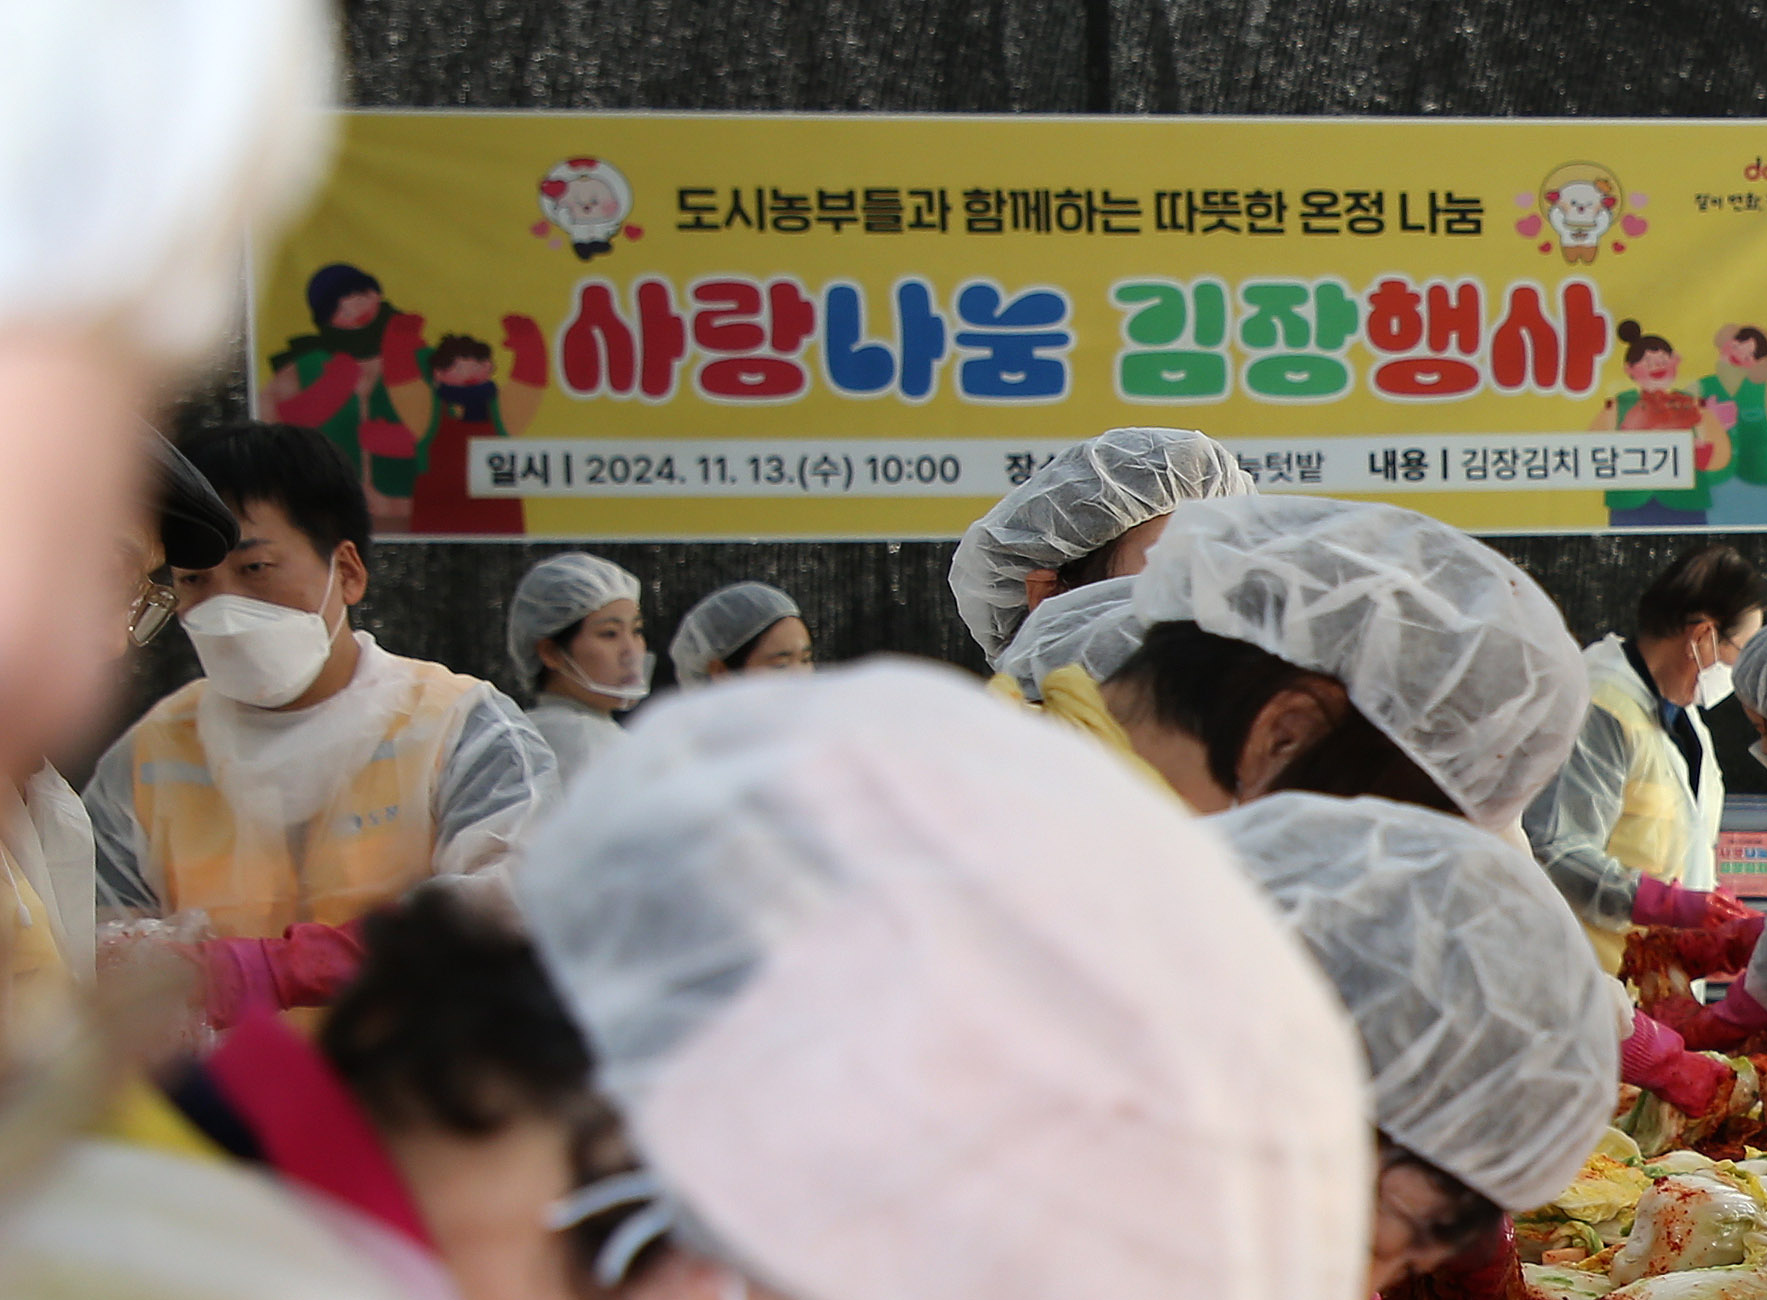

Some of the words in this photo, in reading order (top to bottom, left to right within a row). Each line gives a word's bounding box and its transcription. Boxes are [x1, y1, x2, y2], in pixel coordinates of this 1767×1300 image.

[676, 187, 951, 233] 도시농부들과
[962, 188, 1143, 234] 함께하는
[1154, 190, 1287, 235] 따뜻한
[1299, 190, 1385, 235] 온정
[1400, 191, 1484, 235] 나눔
[559, 278, 1073, 400] 사랑나눔
[1109, 276, 1609, 399] 김장행사
[486, 453, 549, 486] 일시
[586, 455, 686, 485] 2024.
[698, 456, 737, 485] 11.
[867, 454, 960, 484] 10:00
[1369, 449, 1428, 481] 내용
[1461, 448, 1579, 480] 김장김치
[1591, 445, 1679, 480] 담그기
